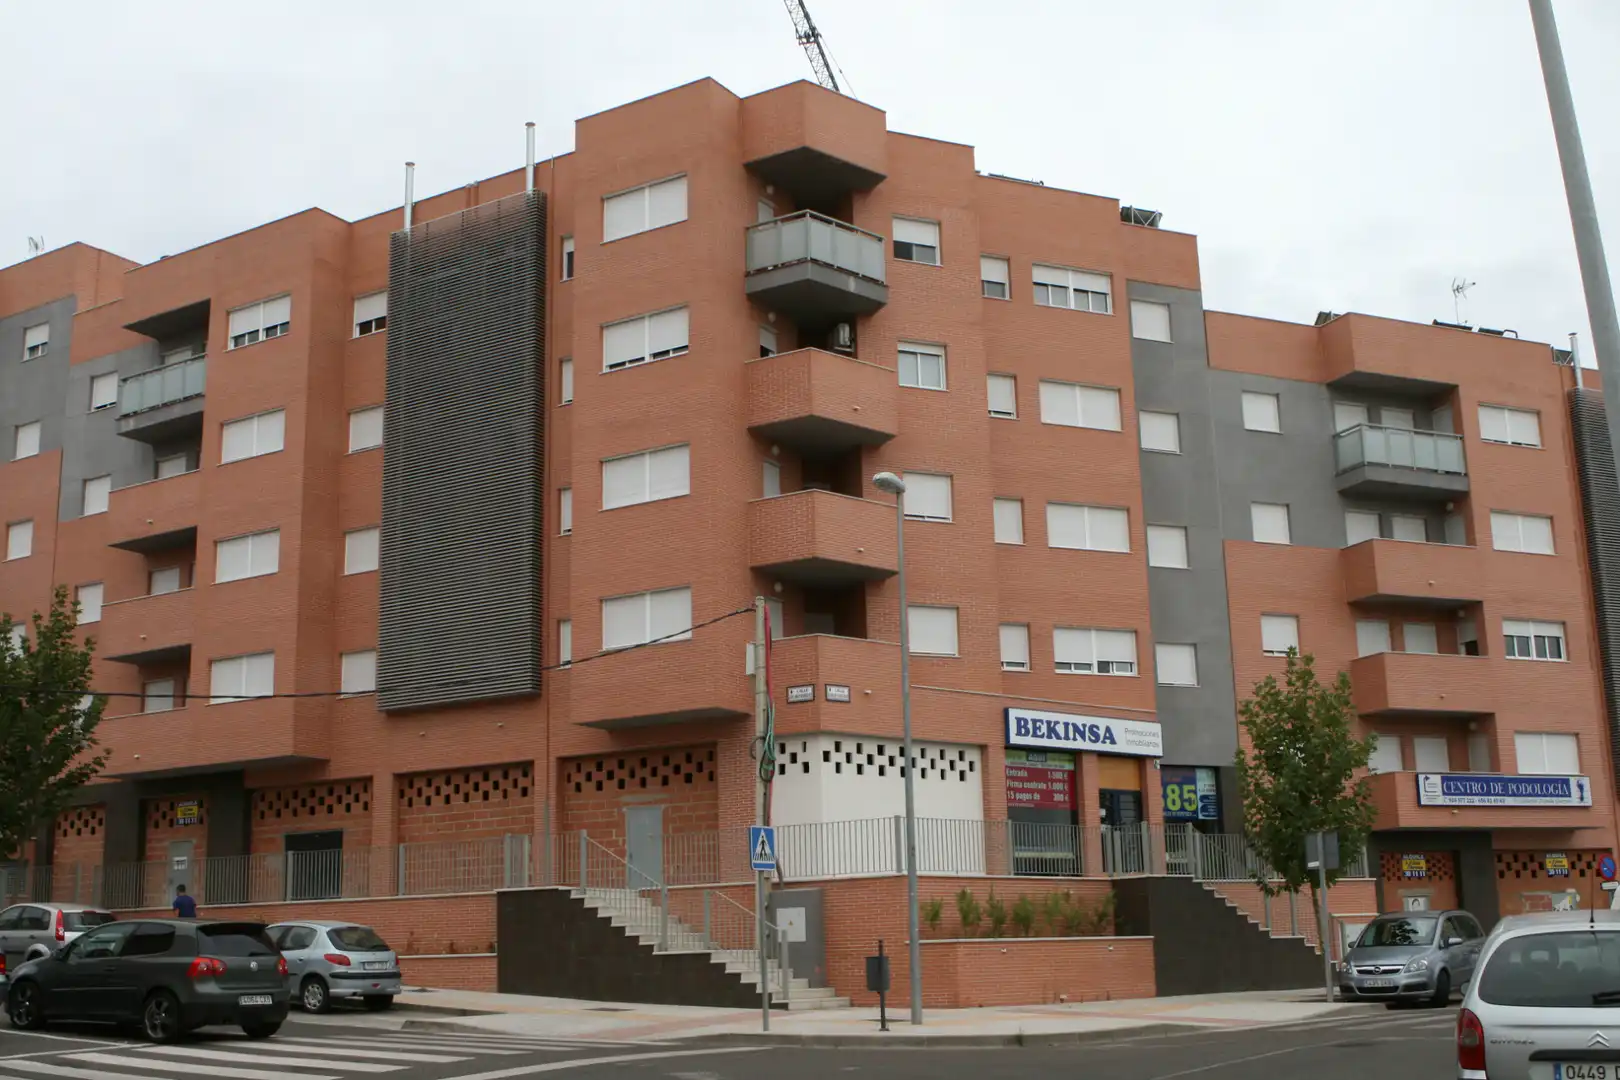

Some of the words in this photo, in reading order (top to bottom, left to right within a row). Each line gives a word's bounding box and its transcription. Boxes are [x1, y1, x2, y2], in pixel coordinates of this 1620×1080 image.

[1014, 716, 1117, 745] BEKINSA
[1124, 727, 1160, 739] Promociones
[1006, 767, 1028, 777] Entrada
[1006, 780, 1022, 788] Firma
[1023, 781, 1047, 789] contrato
[1443, 781, 1487, 793] CENTRO
[1490, 782, 1505, 794] DE
[1508, 780, 1569, 795] PODOLOGÍA
[1007, 790, 1015, 799] 15
[1015, 792, 1032, 801] pagos
[1033, 792, 1040, 800] de
[1161, 784, 1198, 811] 85
[1565, 1065, 1606, 1080] 0449
